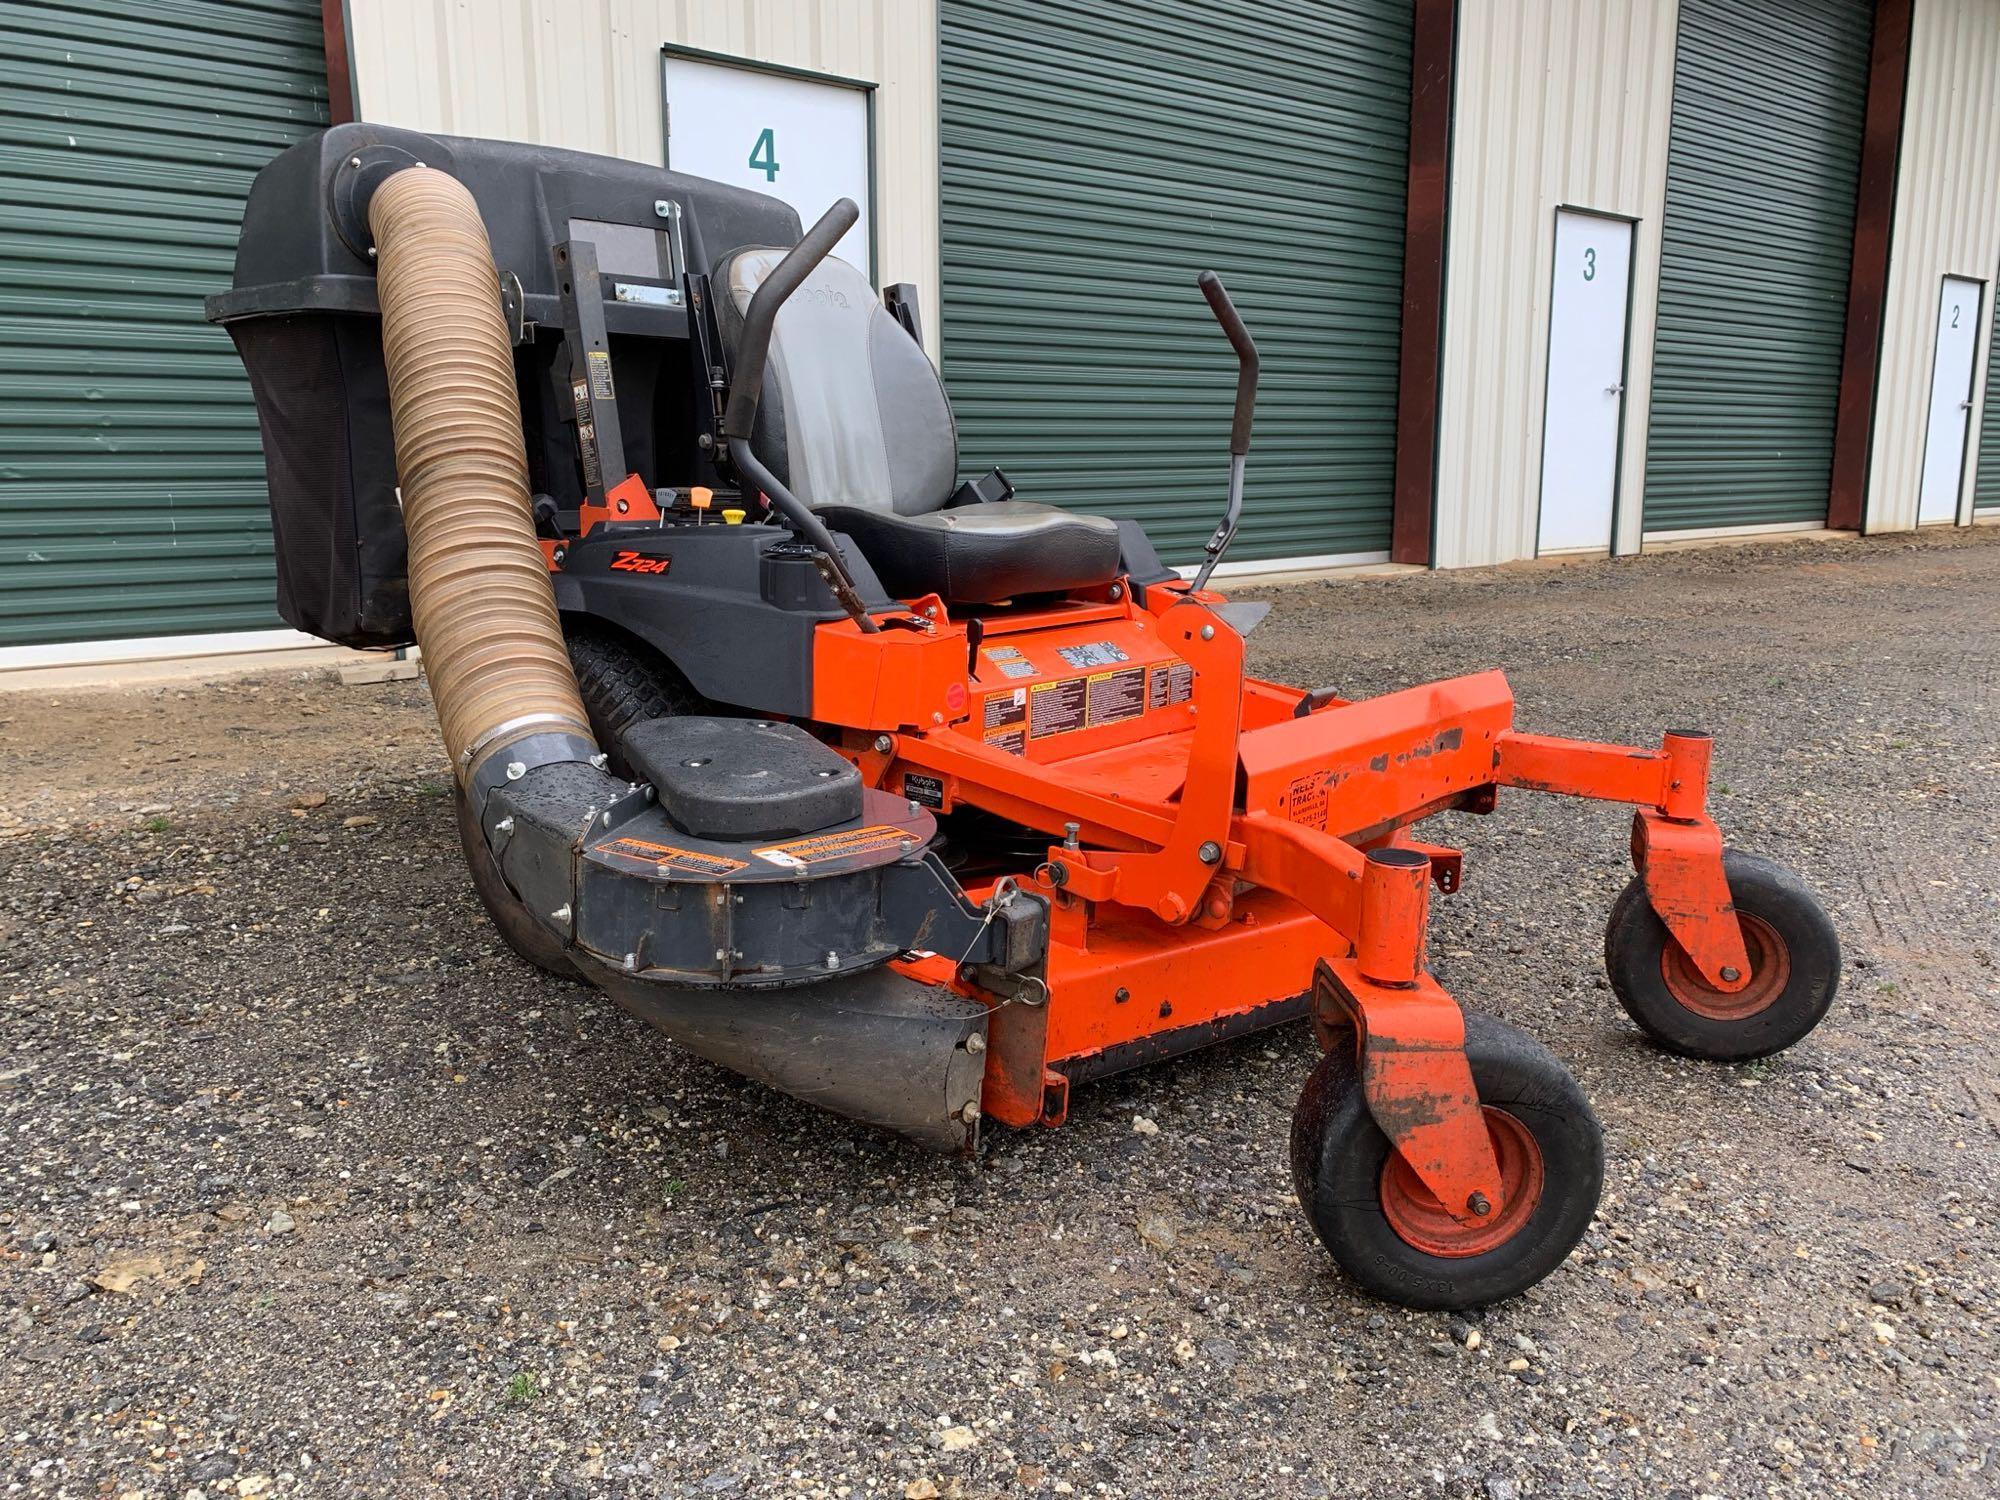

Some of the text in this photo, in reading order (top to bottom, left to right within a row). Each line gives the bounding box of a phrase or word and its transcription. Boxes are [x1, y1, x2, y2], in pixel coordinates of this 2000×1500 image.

[749, 128, 780, 183] 4
[1583, 247, 1596, 282] 3
[1951, 304, 1960, 329] 2
[611, 551, 669, 574] Z724
